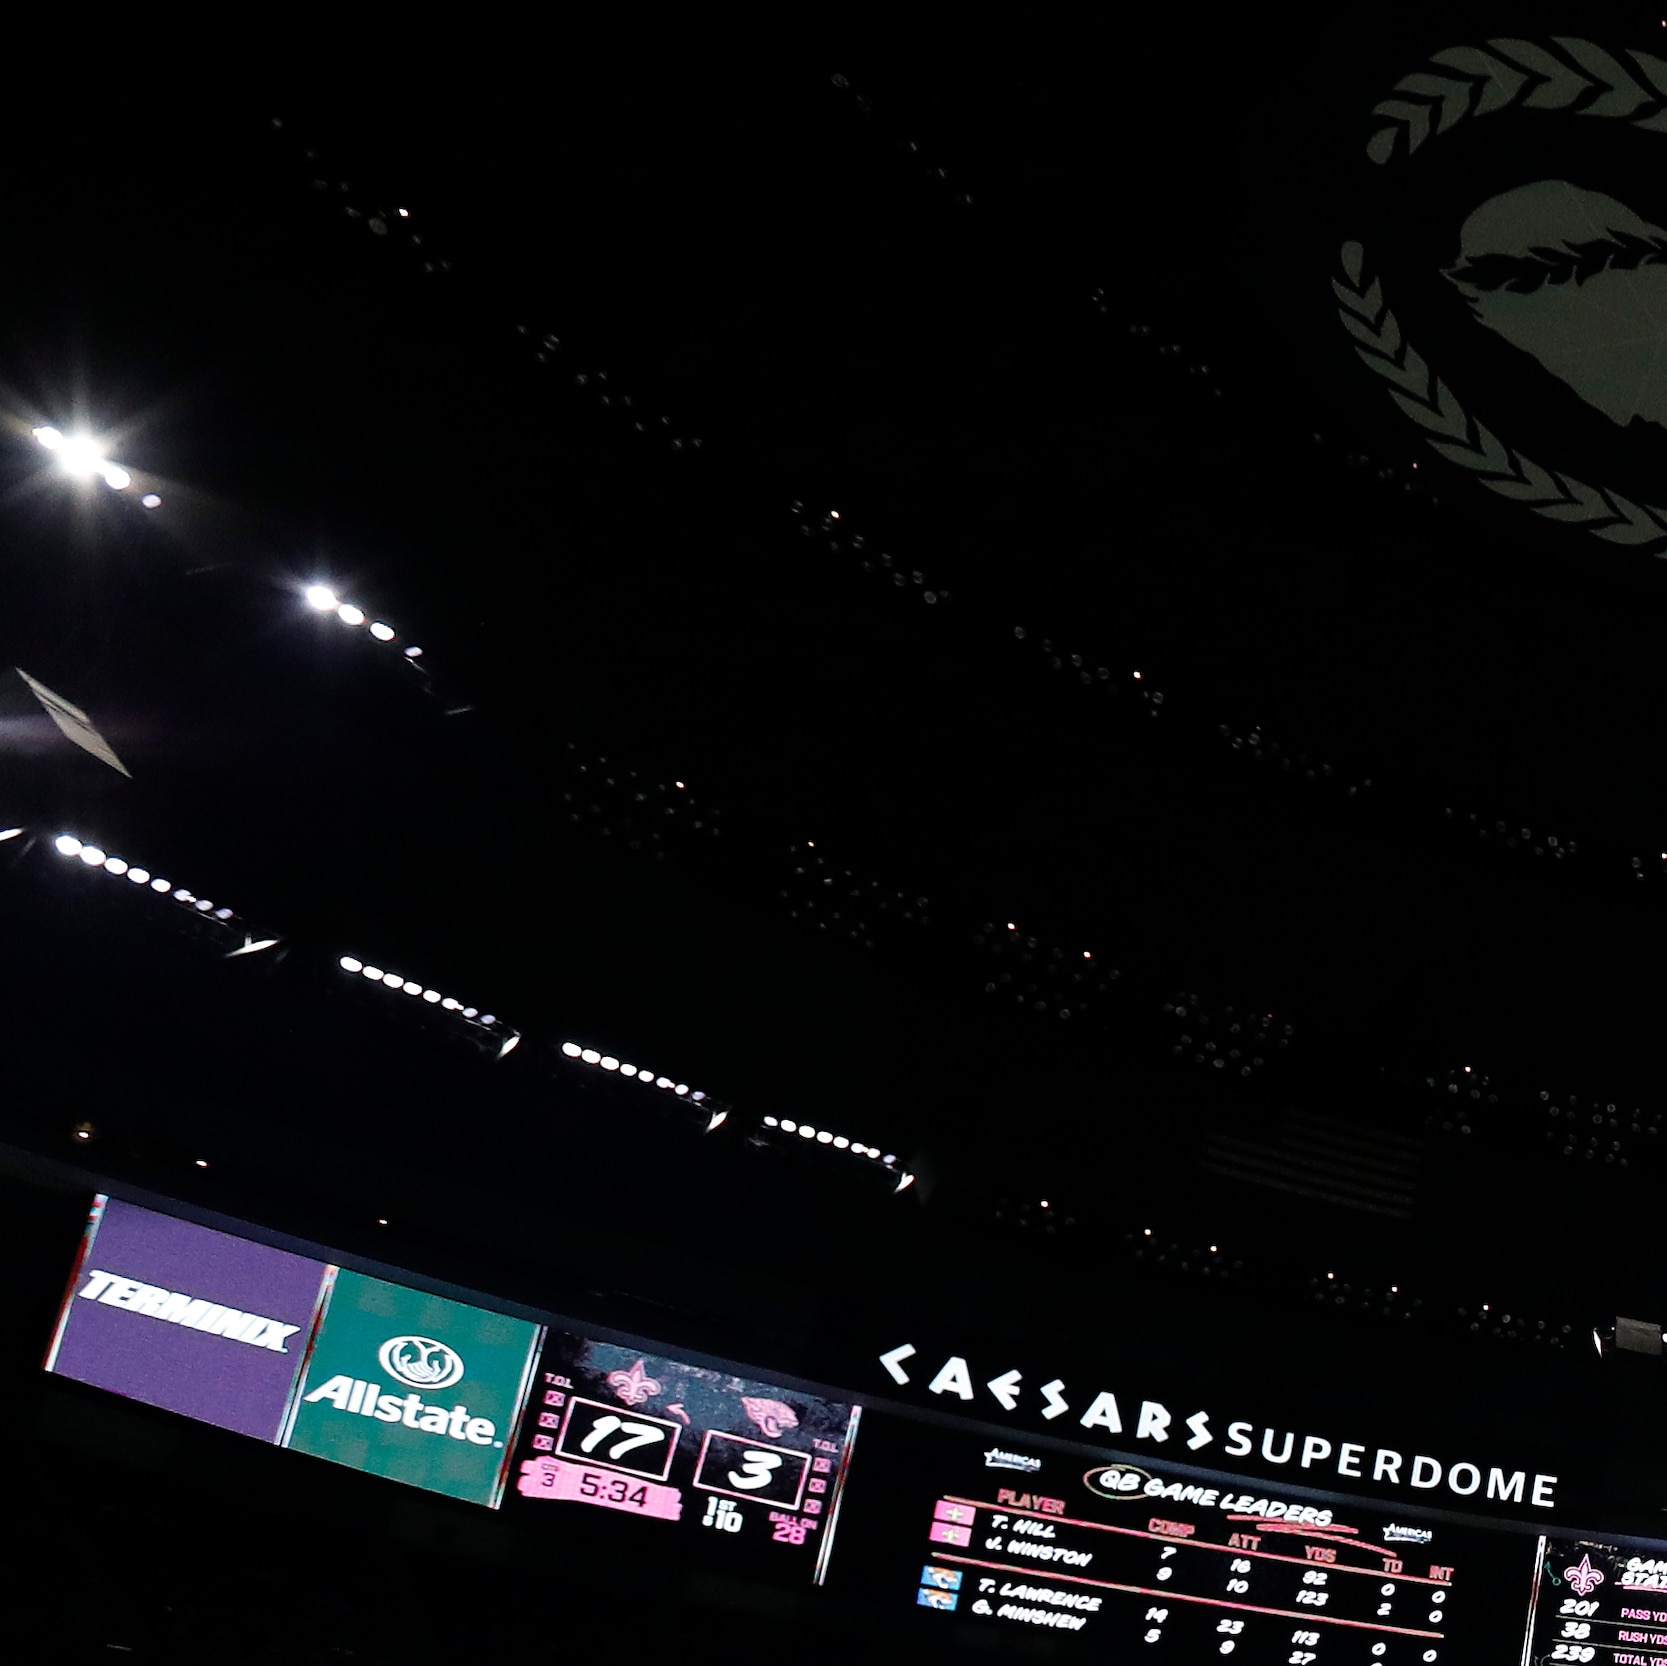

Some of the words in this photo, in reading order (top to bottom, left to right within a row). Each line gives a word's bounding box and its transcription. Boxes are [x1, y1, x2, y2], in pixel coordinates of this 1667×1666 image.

[77, 1269, 301, 1353] TERMINIX
[580, 1415, 665, 1460] 17
[879, 1343, 1213, 1451] CAESARS
[1224, 1421, 1559, 1509] SUPERDOME
[542, 1472, 555, 1488] 3
[580, 1473, 648, 1508] 5:34
[728, 1450, 783, 1490] 3
[1099, 1470, 1141, 1491] QB
[1143, 1478, 1220, 1507] GAME
[1219, 1493, 1333, 1527] LEADERS
[714, 1511, 743, 1533] 10
[772, 1523, 807, 1545] 28
[997, 1488, 1066, 1515] PLAYER
[1148, 1517, 1196, 1538] COMP
[1228, 1532, 1262, 1550] ATT
[1304, 1545, 1337, 1563] YDS
[1382, 1557, 1403, 1574] TD
[1429, 1565, 1454, 1582] INT
[985, 1537, 1003, 1551] J.
[1007, 1540, 1093, 1567] WINSTON
[1156, 1567, 1172, 1580] 9
[1226, 1578, 1249, 1594] 10
[1295, 1590, 1329, 1606] 123
[1376, 1602, 1392, 1616] 2
[1428, 1610, 1443, 1623] 0
[991, 1514, 1009, 1530] T.
[1012, 1518, 1056, 1538] HILL
[1160, 1546, 1177, 1559] 7
[1302, 1570, 1328, 1586] 92
[1381, 1583, 1396, 1597] 0
[1431, 1590, 1446, 1604] 0
[971, 1600, 993, 1615] G.
[997, 1603, 1087, 1631] MINSHEW
[1144, 1629, 1162, 1643] 5
[1219, 1640, 1235, 1654] 9
[1288, 1650, 1316, 1665] 27
[978, 1578, 996, 1594] T.
[999, 1583, 1102, 1612] LAWRENCE
[1145, 1607, 1168, 1623] 14
[1216, 1619, 1244, 1634] 23
[1291, 1630, 1320, 1646] 113
[1371, 1642, 1386, 1656] 0
[1422, 1650, 1437, 1663] 0
[1559, 1599, 1600, 1617] 201
[1621, 1608, 1650, 1621] PASS
[1561, 1621, 1591, 1640] 38
[1618, 1630, 1648, 1644] RUSH
[1551, 1644, 1595, 1663] 239
[1613, 1653, 1647, 1666] TOTAL
